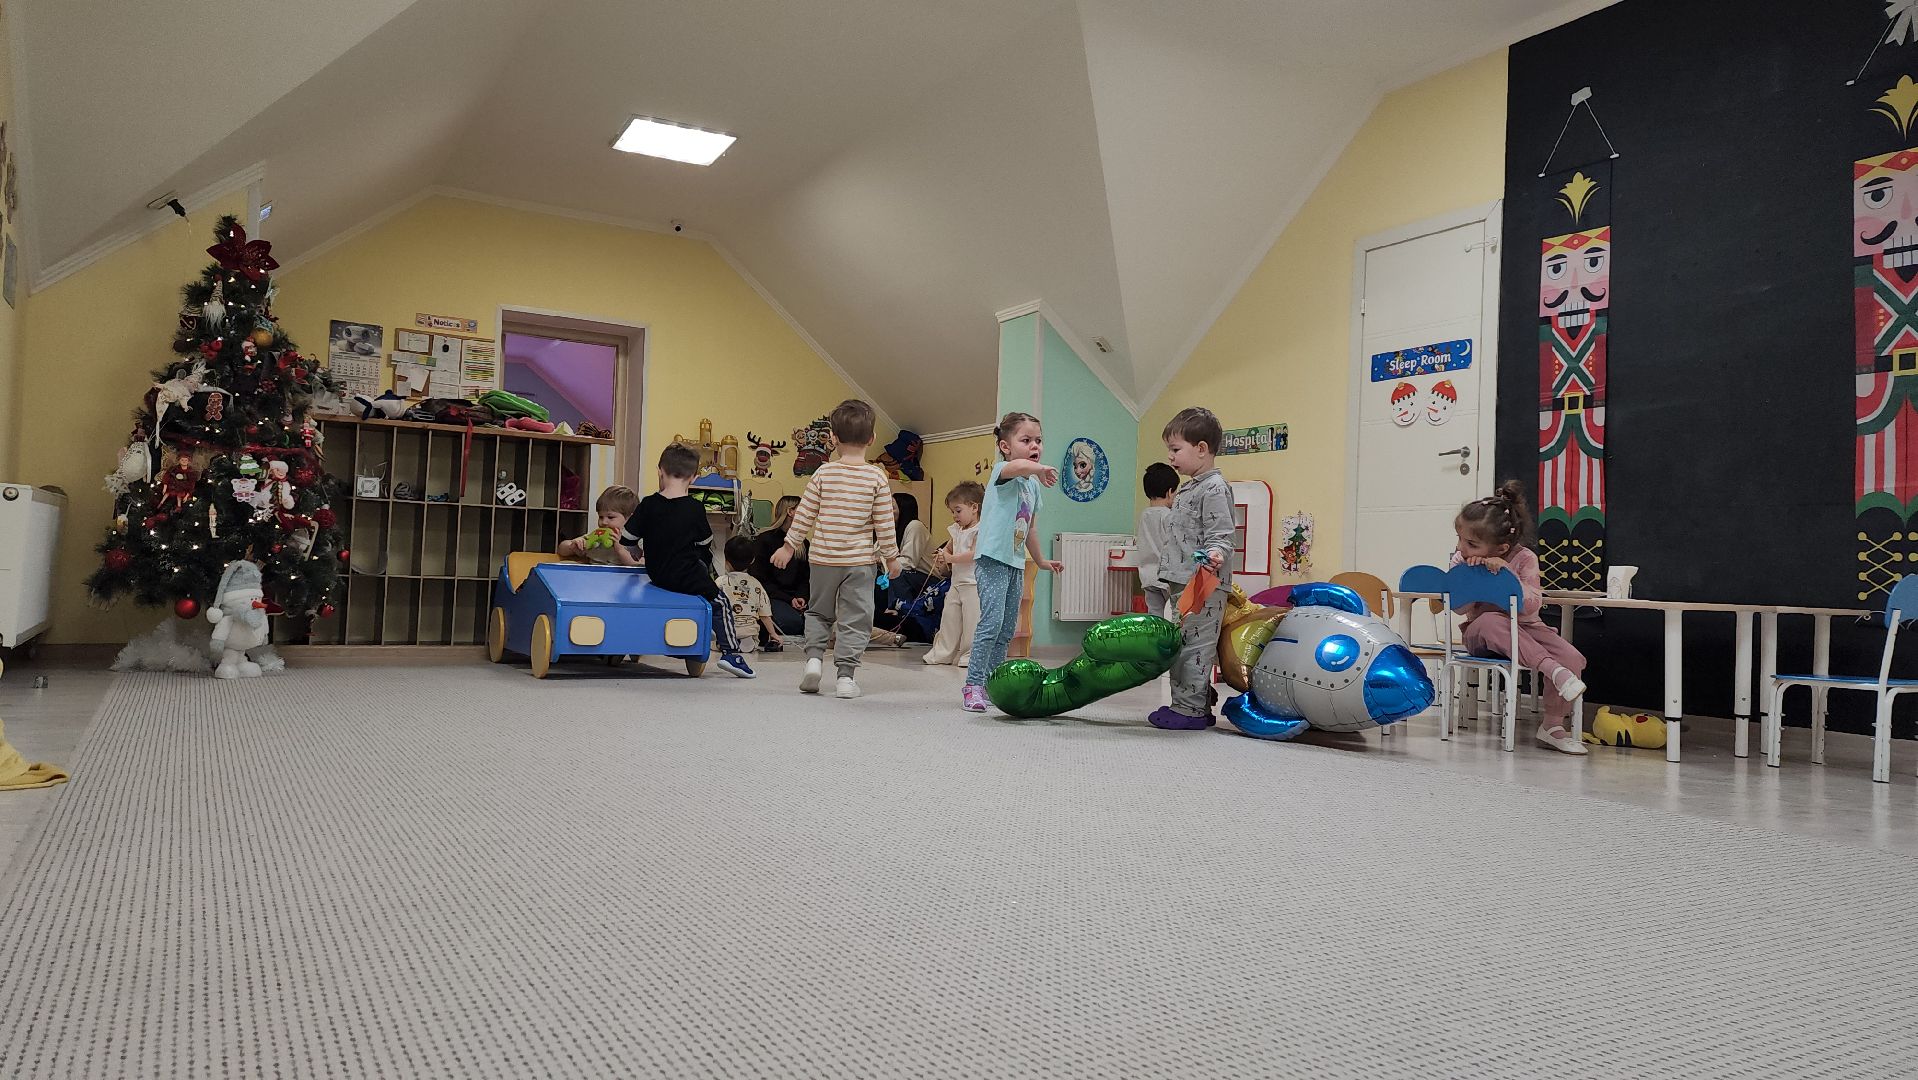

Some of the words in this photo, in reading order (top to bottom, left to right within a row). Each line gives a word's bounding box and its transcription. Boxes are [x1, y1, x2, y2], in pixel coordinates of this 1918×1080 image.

[1389, 360, 1417, 371] Sleep
[1421, 353, 1451, 366] Room
[1225, 429, 1272, 449] Hospital
